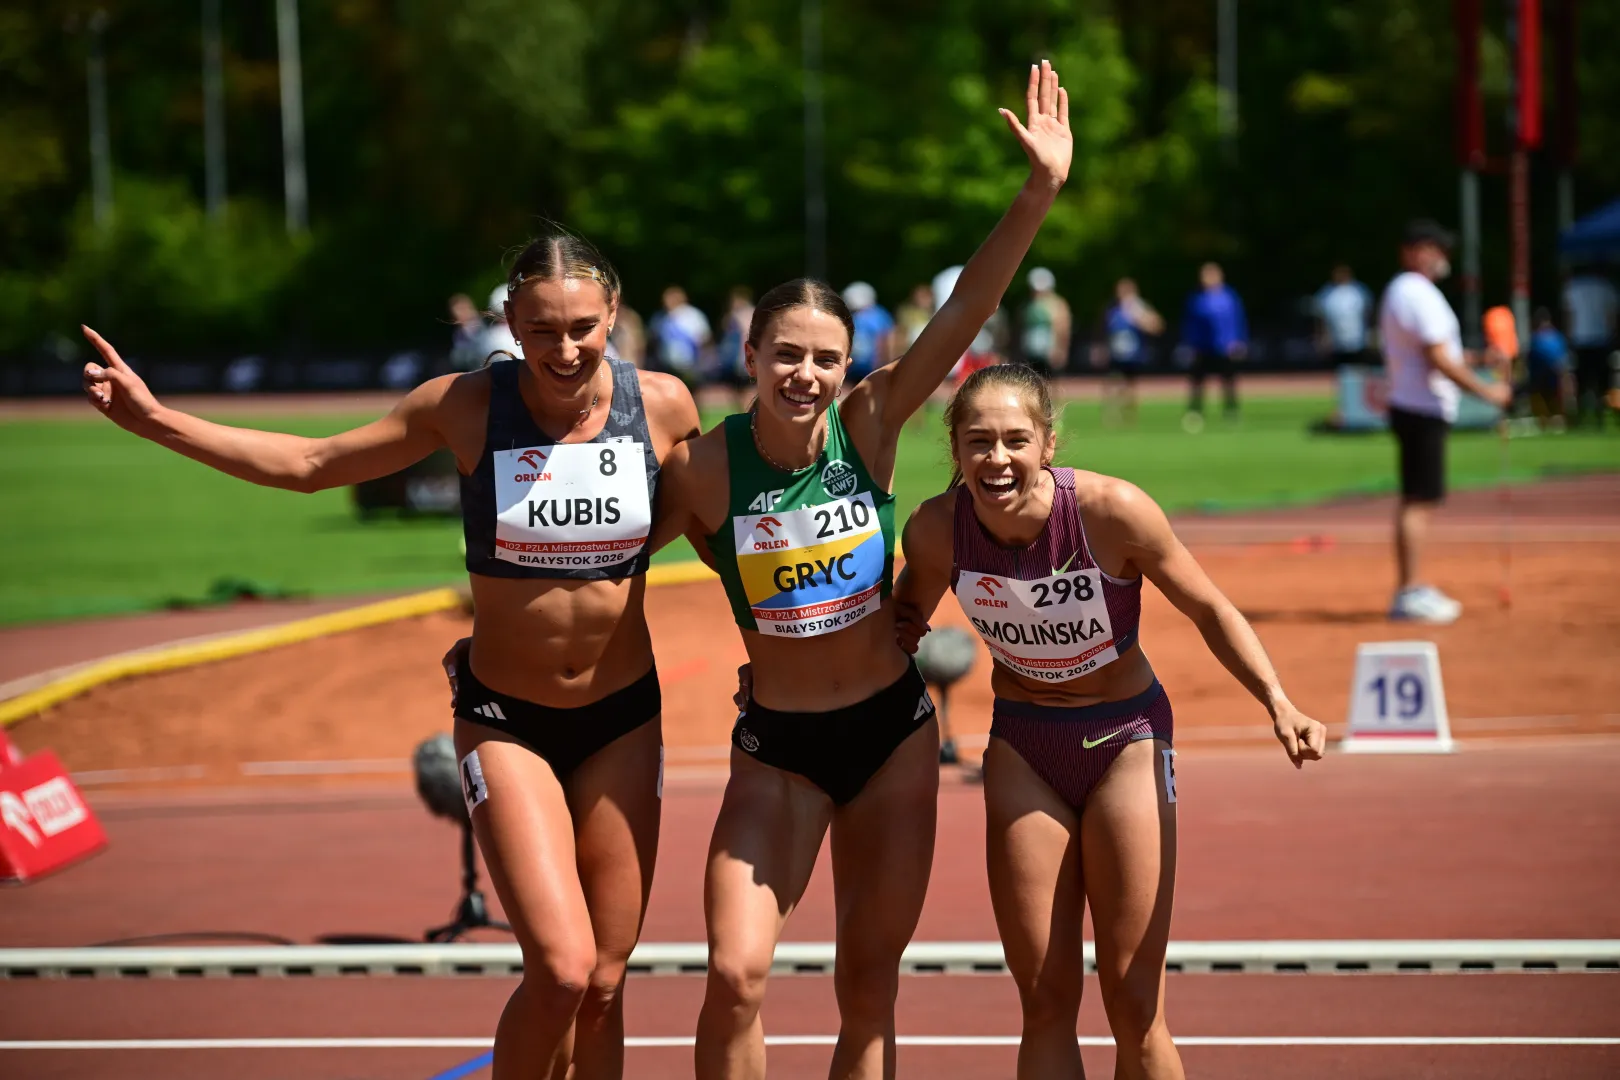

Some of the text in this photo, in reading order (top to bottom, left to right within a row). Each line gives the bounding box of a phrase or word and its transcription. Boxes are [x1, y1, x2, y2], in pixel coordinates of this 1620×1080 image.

[599, 448, 617, 476] 8
[827, 465, 846, 479] AZS
[514, 472, 552, 483] ORLEN
[831, 478, 853, 495] AWF
[528, 497, 621, 528] KUBIS
[814, 500, 870, 539] 210
[505, 540, 641, 552] 102. PZLA Mistrzostwa Polski
[518, 552, 624, 565] BIAŁYSTOK 2026
[753, 539, 789, 551] ORLEN
[773, 553, 857, 593] GRYC
[974, 598, 1008, 609] ORLEN
[1030, 574, 1095, 609] 298
[759, 610, 776, 620] 102.
[776, 610, 799, 620] PZLA
[799, 599, 857, 618] Mistrzostwa
[774, 605, 867, 635] BIAŁYSTOK 2026
[971, 617, 1105, 646] SMOLIŃSKA
[1022, 642, 1108, 669] Mistrzostwa Polski
[1066, 659, 1097, 678] 2026
[1366, 672, 1425, 720] 19
[462, 760, 479, 804] 4
